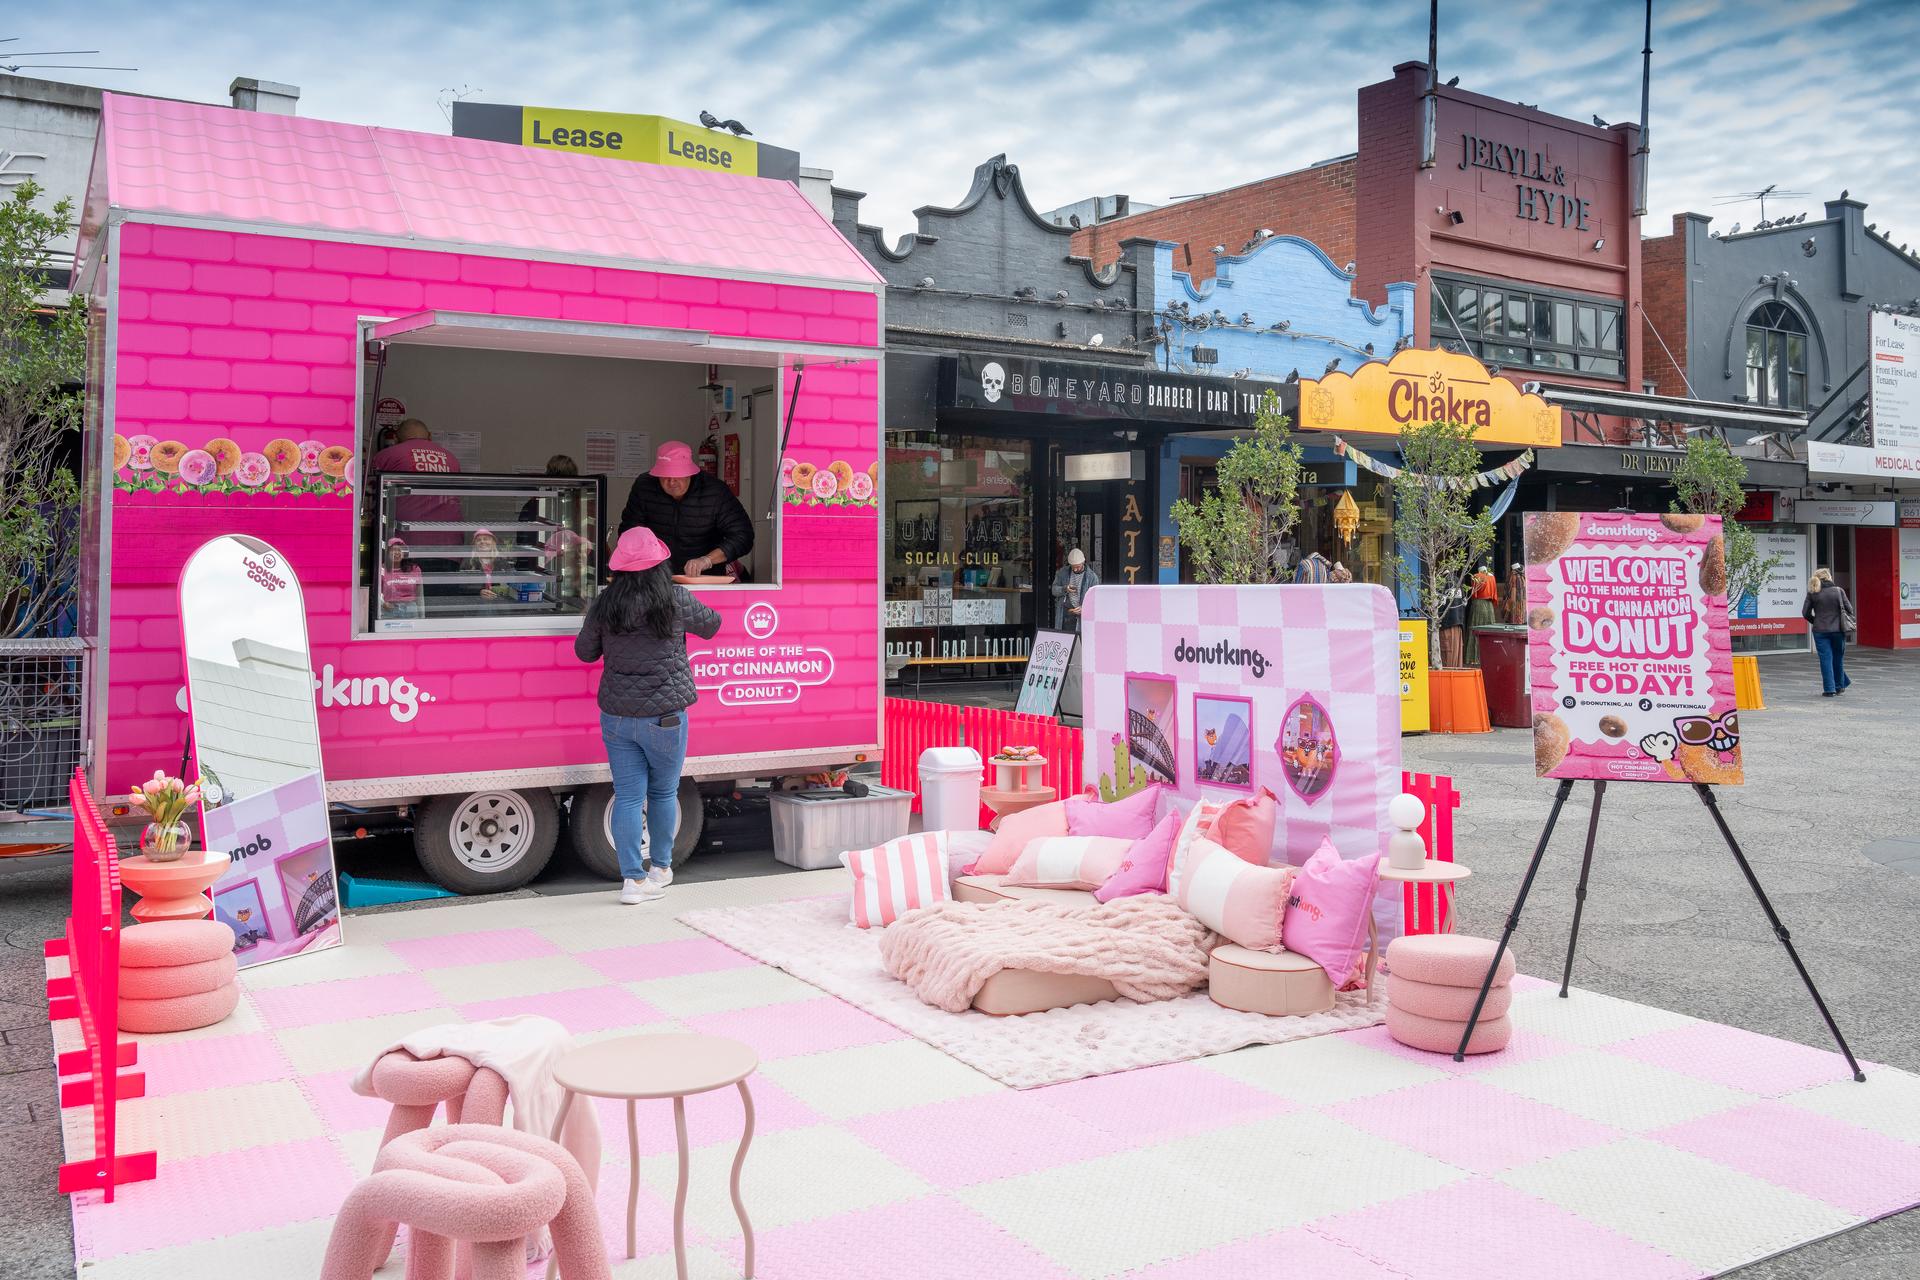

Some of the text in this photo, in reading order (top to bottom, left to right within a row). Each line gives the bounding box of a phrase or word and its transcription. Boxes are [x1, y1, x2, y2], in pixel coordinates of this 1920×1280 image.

[533, 120, 623, 149] Lease
[668, 131, 732, 169] Lease
[1458, 134, 1565, 186] JEKYLL &
[1516, 184, 1590, 231] HYDE
[1012, 373, 1142, 404] BONEYARD
[1149, 385, 1192, 409] BARBER
[1207, 390, 1228, 411] BAR
[1388, 378, 1491, 427] Chakra
[413, 452, 447, 464] HOT
[1622, 453, 1640, 470] DR
[1875, 456, 1914, 470] MEDICAL
[905, 551, 999, 565] SOCIAL CLUB
[242, 556, 286, 589] LOOKING
[247, 570, 276, 592] GOOD
[1564, 559, 1685, 586] WELCOME
[1575, 584, 1677, 597] TO THE HOME OF THE
[1566, 594, 1691, 617] HOT CINNAMON
[1568, 612, 1692, 654] DONUT
[1729, 624, 1746, 632] verybody
[717, 646, 803, 658] HOME OF THE
[1035, 640, 1069, 666] BYSC
[1399, 650, 1411, 659] ive
[694, 660, 823, 677] HOT CINNAMON
[1569, 661, 1692, 674] FREE HOT CINNIS
[735, 686, 784, 699] DONUT
[1028, 673, 1059, 690] OPEN
[1568, 672, 1694, 697] TODAY!
